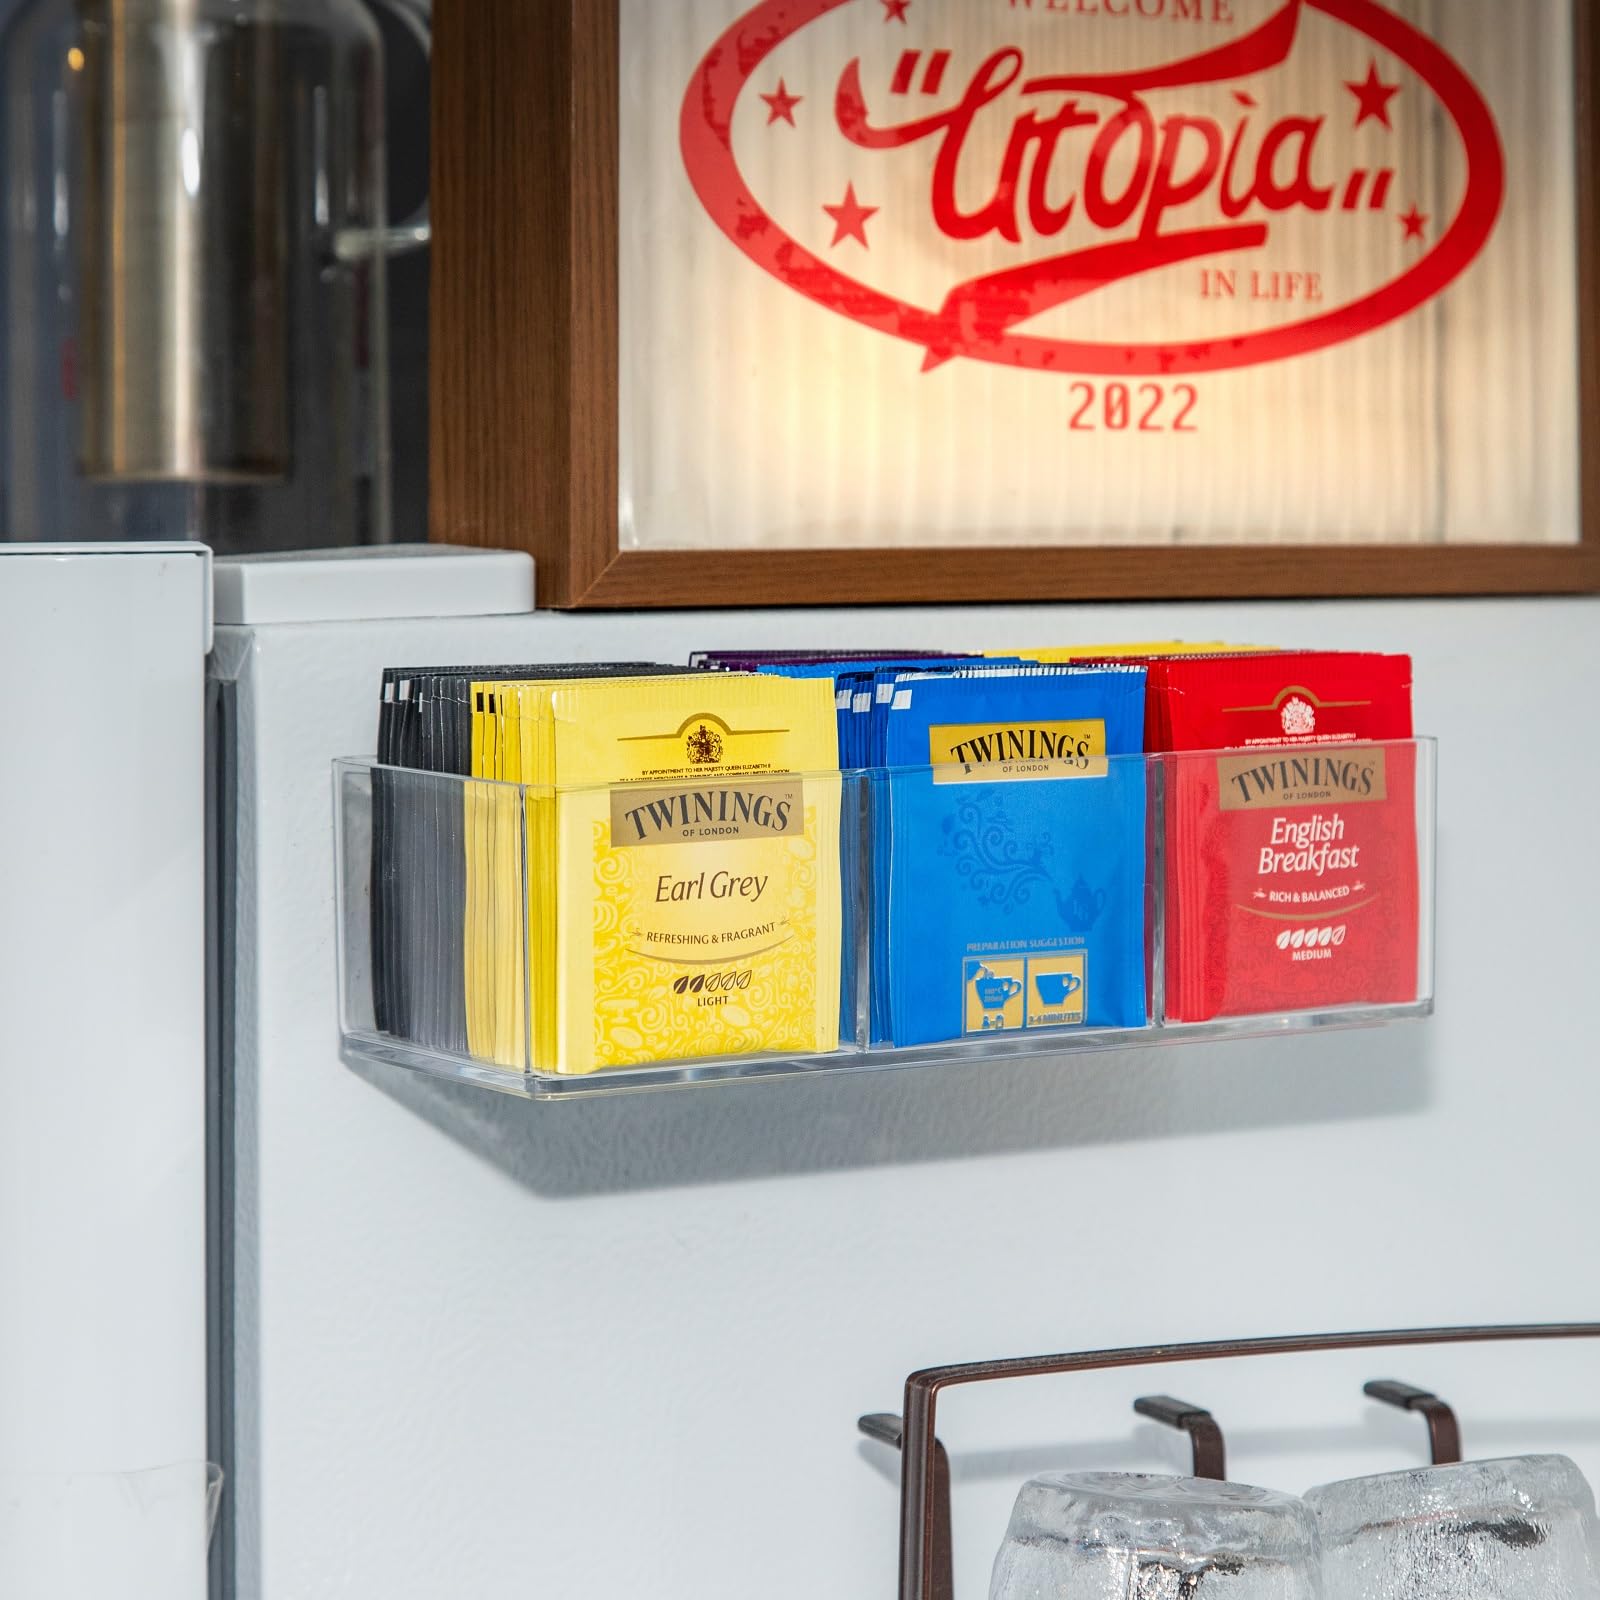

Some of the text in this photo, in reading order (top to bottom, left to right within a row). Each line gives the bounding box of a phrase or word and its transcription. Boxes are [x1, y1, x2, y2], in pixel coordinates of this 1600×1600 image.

[1200, 268, 1323, 302] IN LIFE
[1069, 381, 1198, 430] 2022
[1016, 764, 1049, 772] LONDON
[1232, 758, 1374, 802] TWININGS
[1297, 790, 1331, 800] LONDON
[626, 791, 791, 840] TWININGS
[682, 826, 739, 837] OF LONDON
[1271, 812, 1344, 848] English
[1258, 843, 1360, 876] Breakfast
[656, 870, 768, 902] Earl Grey
[1269, 886, 1350, 902] RICH & BALANCED
[646, 922, 776, 944] REFRESHING & FRAGRANT
[966, 936, 1085, 952] PREPARATION SUGGESTION
[1292, 949, 1332, 960] MEDIUM
[697, 996, 729, 1007] LIGHT
